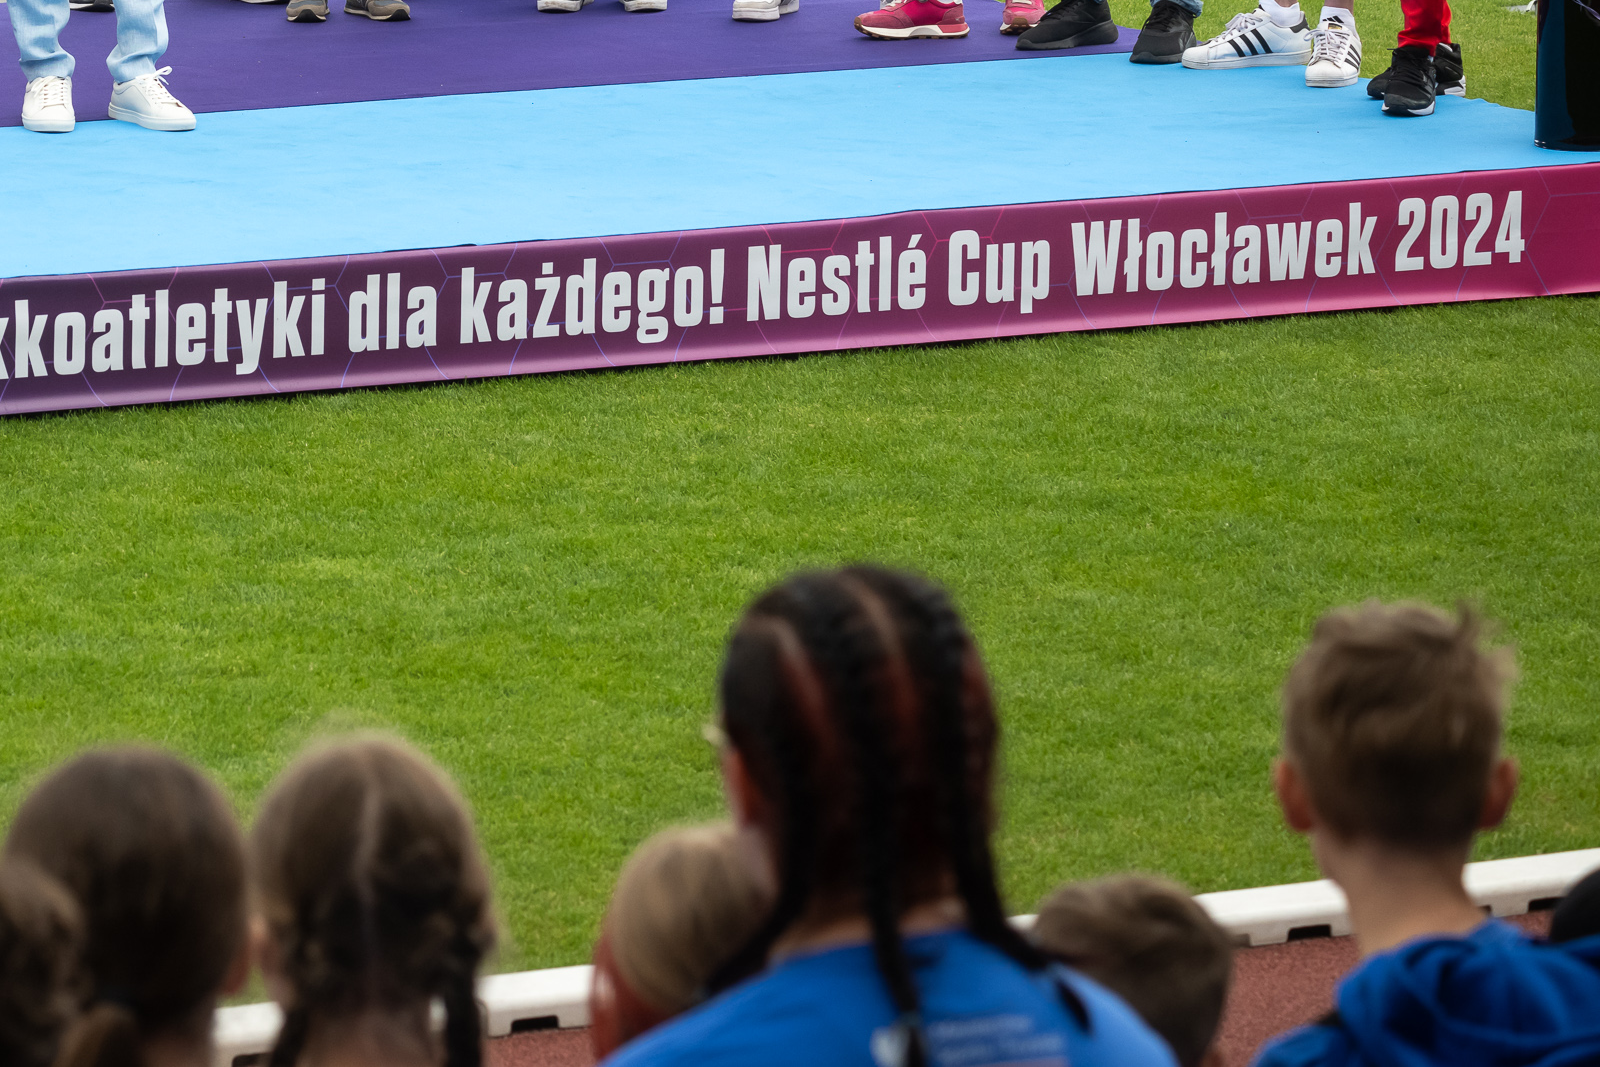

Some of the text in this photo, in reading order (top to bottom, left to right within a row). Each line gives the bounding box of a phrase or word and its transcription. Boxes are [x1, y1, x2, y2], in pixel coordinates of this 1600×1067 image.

[348, 272, 437, 352] dla
[459, 249, 725, 345] każdego!
[746, 233, 927, 322] Nestlé
[947, 228, 1051, 314] Cup
[1070, 201, 1377, 297] Włocławek
[1395, 190, 1525, 272] 2024
